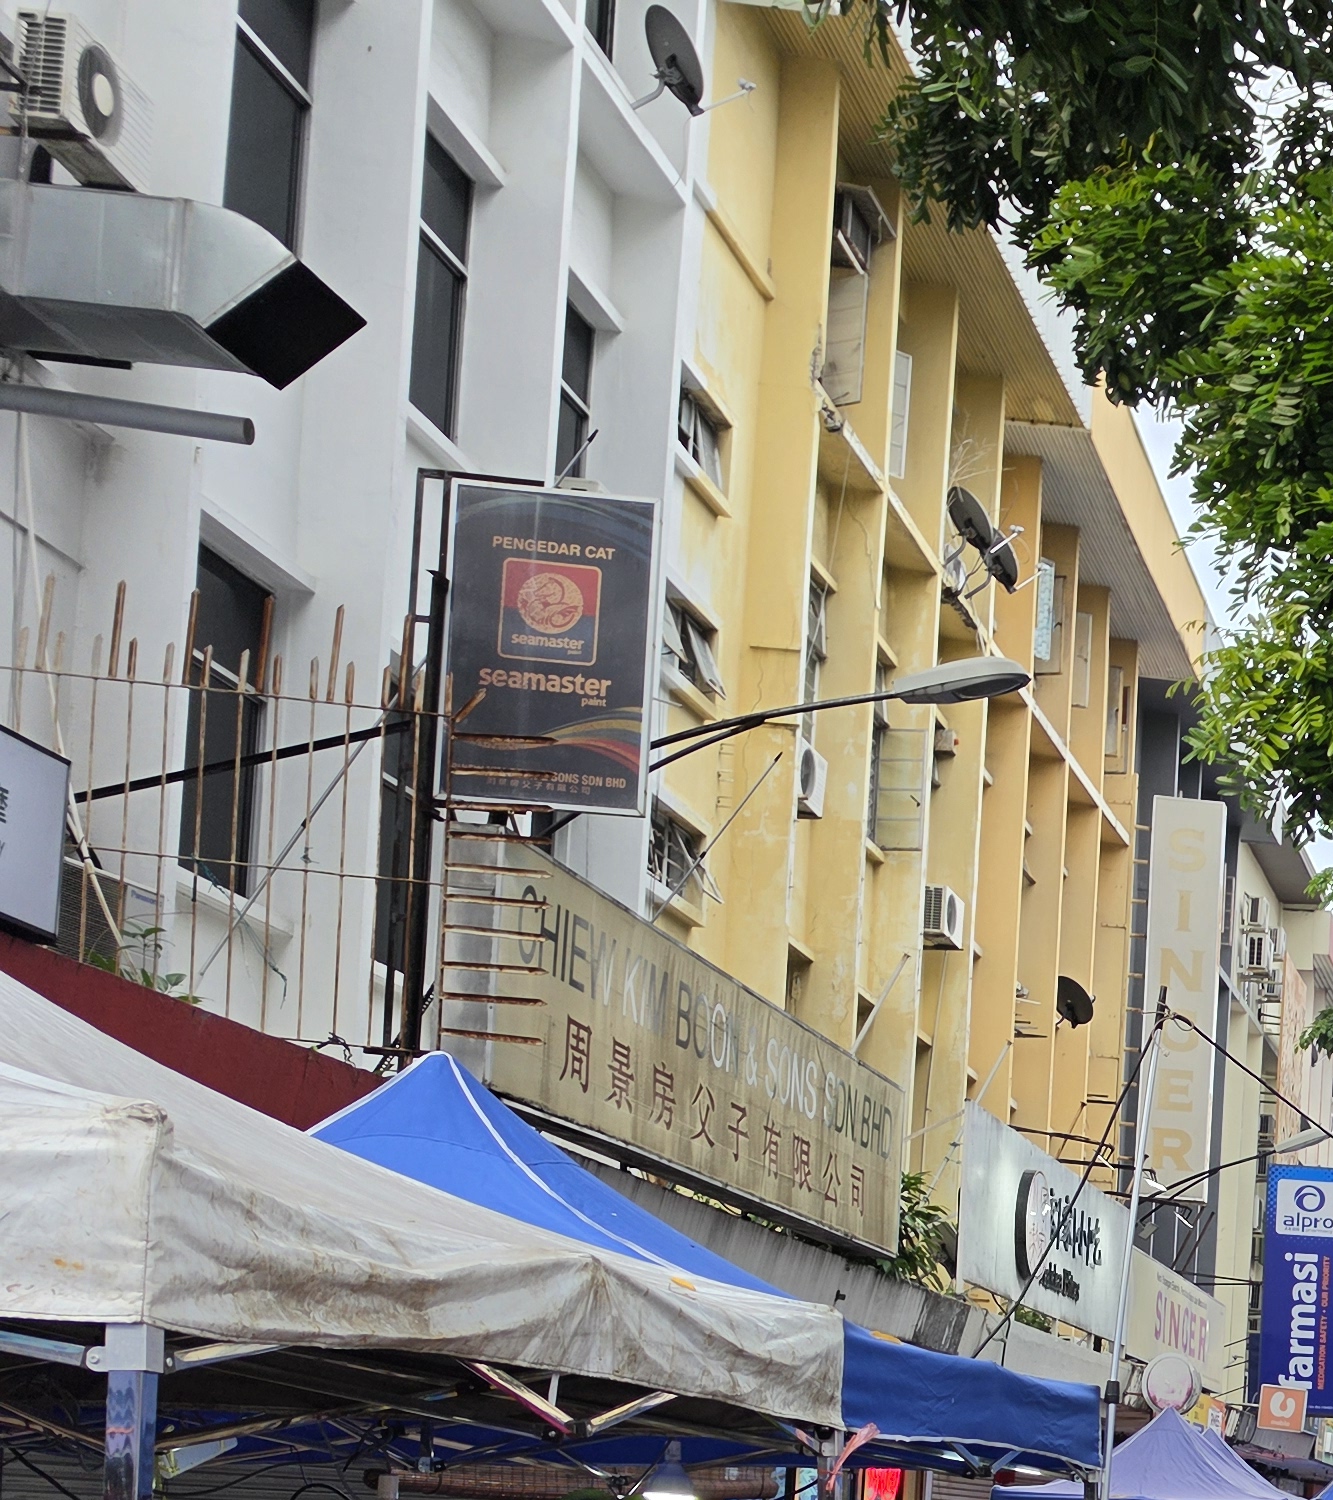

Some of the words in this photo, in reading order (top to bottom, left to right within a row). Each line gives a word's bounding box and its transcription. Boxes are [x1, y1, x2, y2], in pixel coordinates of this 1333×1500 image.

[492, 535, 581, 557] PENGEDAR
[584, 546, 616, 560] CAT
[511, 632, 585, 649] seamaster
[478, 667, 612, 696] seamaster
[581, 696, 607, 707] paint
[581, 774, 603, 787] SDN
[606, 776, 626, 789] BHD
[518, 884, 616, 1006] CHIEW
[622, 947, 669, 1036] KIM
[675, 979, 740, 1082] BOON
[745, 1028, 759, 1087] &
[766, 1037, 818, 1120] SONS
[559, 1014, 866, 1217] 周景房父子有限公司
[1322, 1256, 1331, 1291] PRIORITY
[1321, 1292, 1329, 1307] OUR
[1154, 1290, 1210, 1363] SINGER
[1278, 1252, 1319, 1391] farmasi
[1319, 1315, 1328, 1344] SAFETY
[1317, 1344, 1327, 1390] MEDICATION
